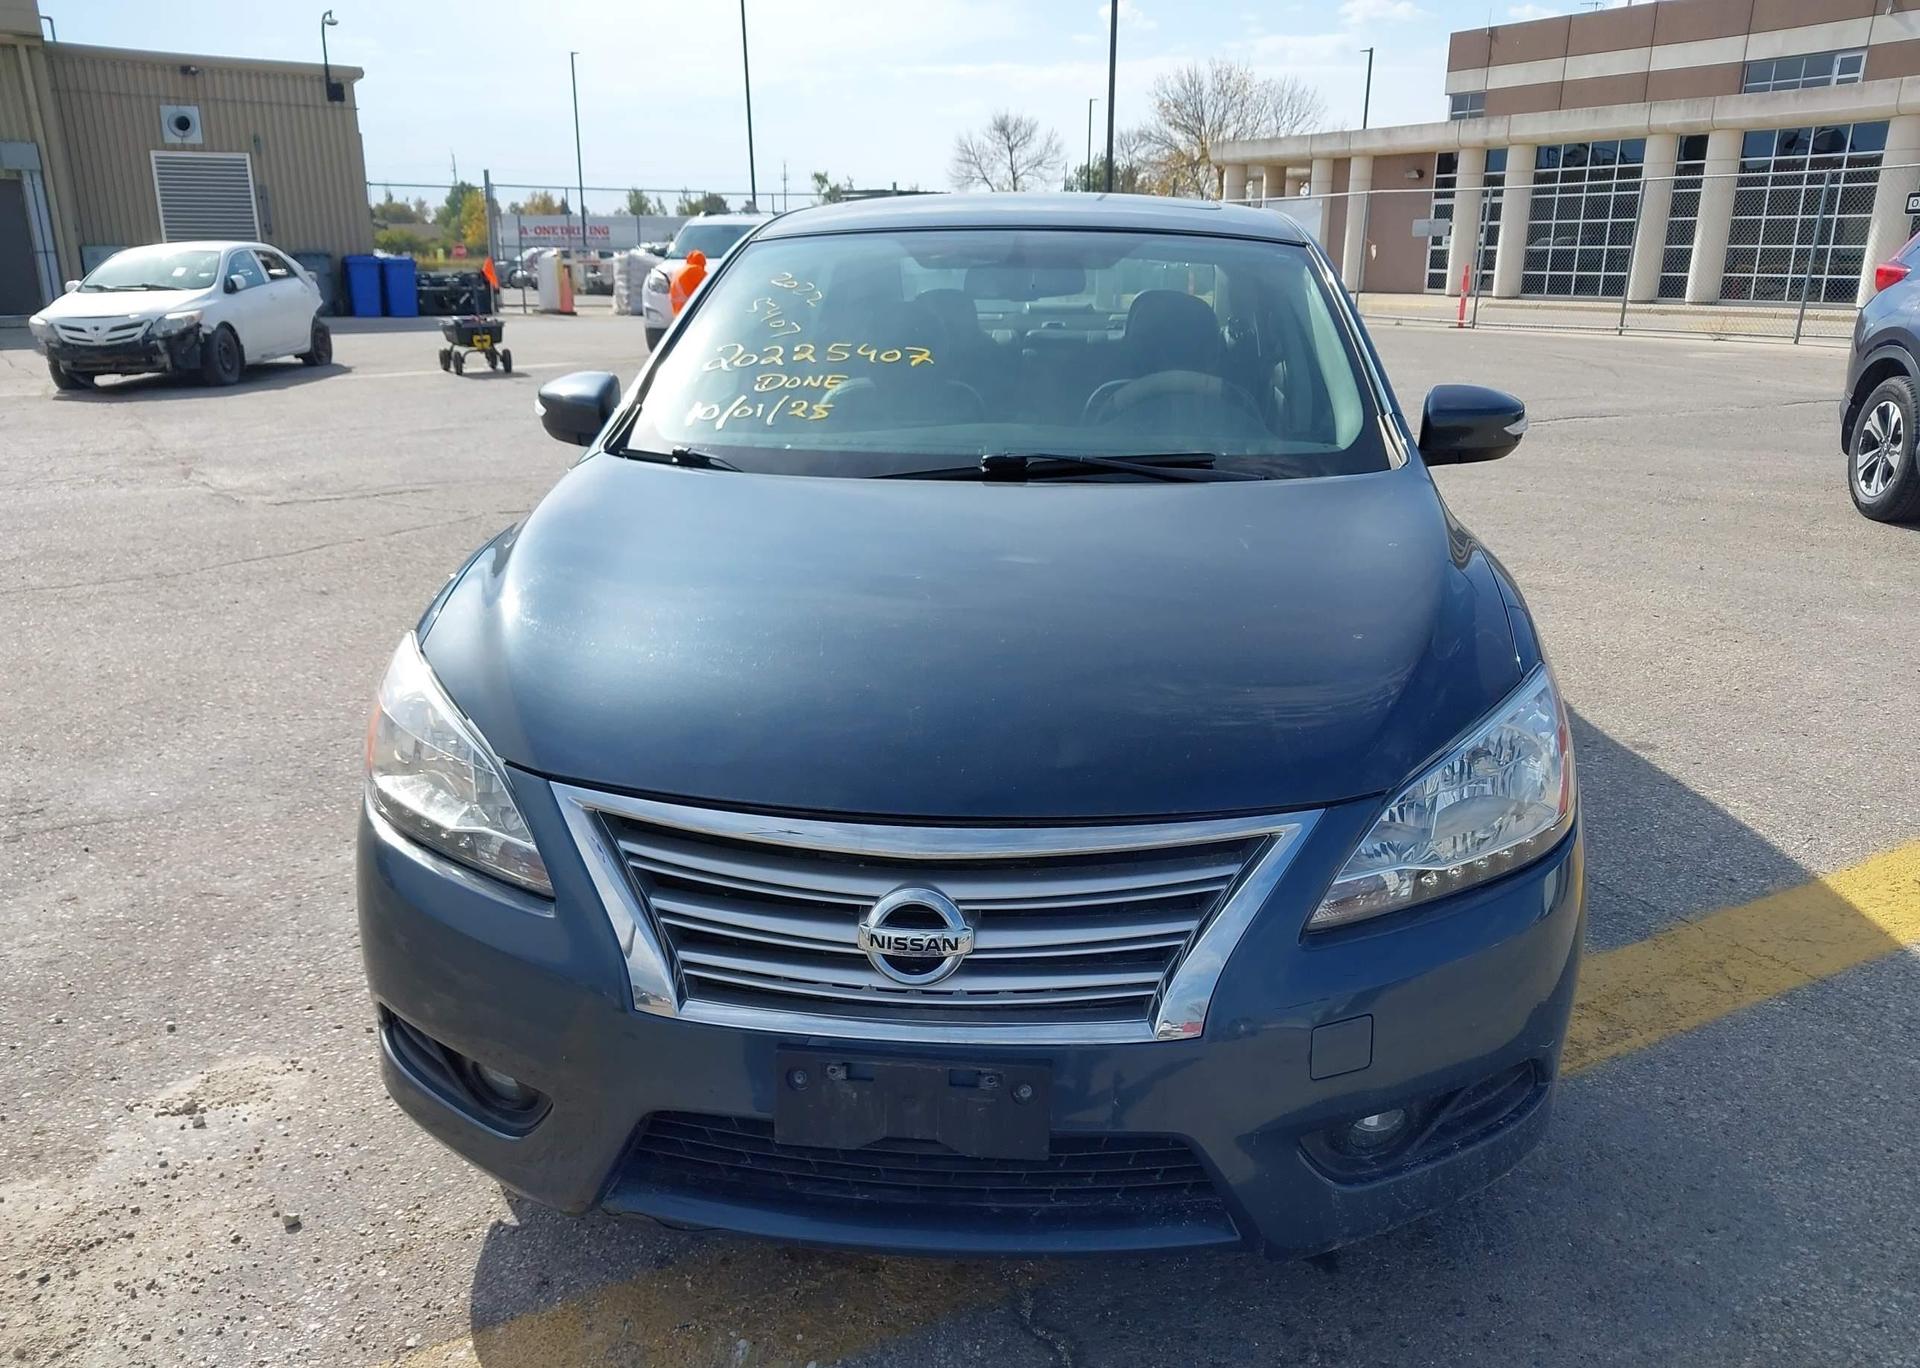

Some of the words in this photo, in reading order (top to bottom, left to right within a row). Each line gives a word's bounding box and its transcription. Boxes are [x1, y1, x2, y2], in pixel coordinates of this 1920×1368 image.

[560, 225, 609, 236] DRIING
[754, 374, 847, 392] DONE
[686, 396, 833, 431] 10/01/25
[870, 934, 957, 952] NISSAN
